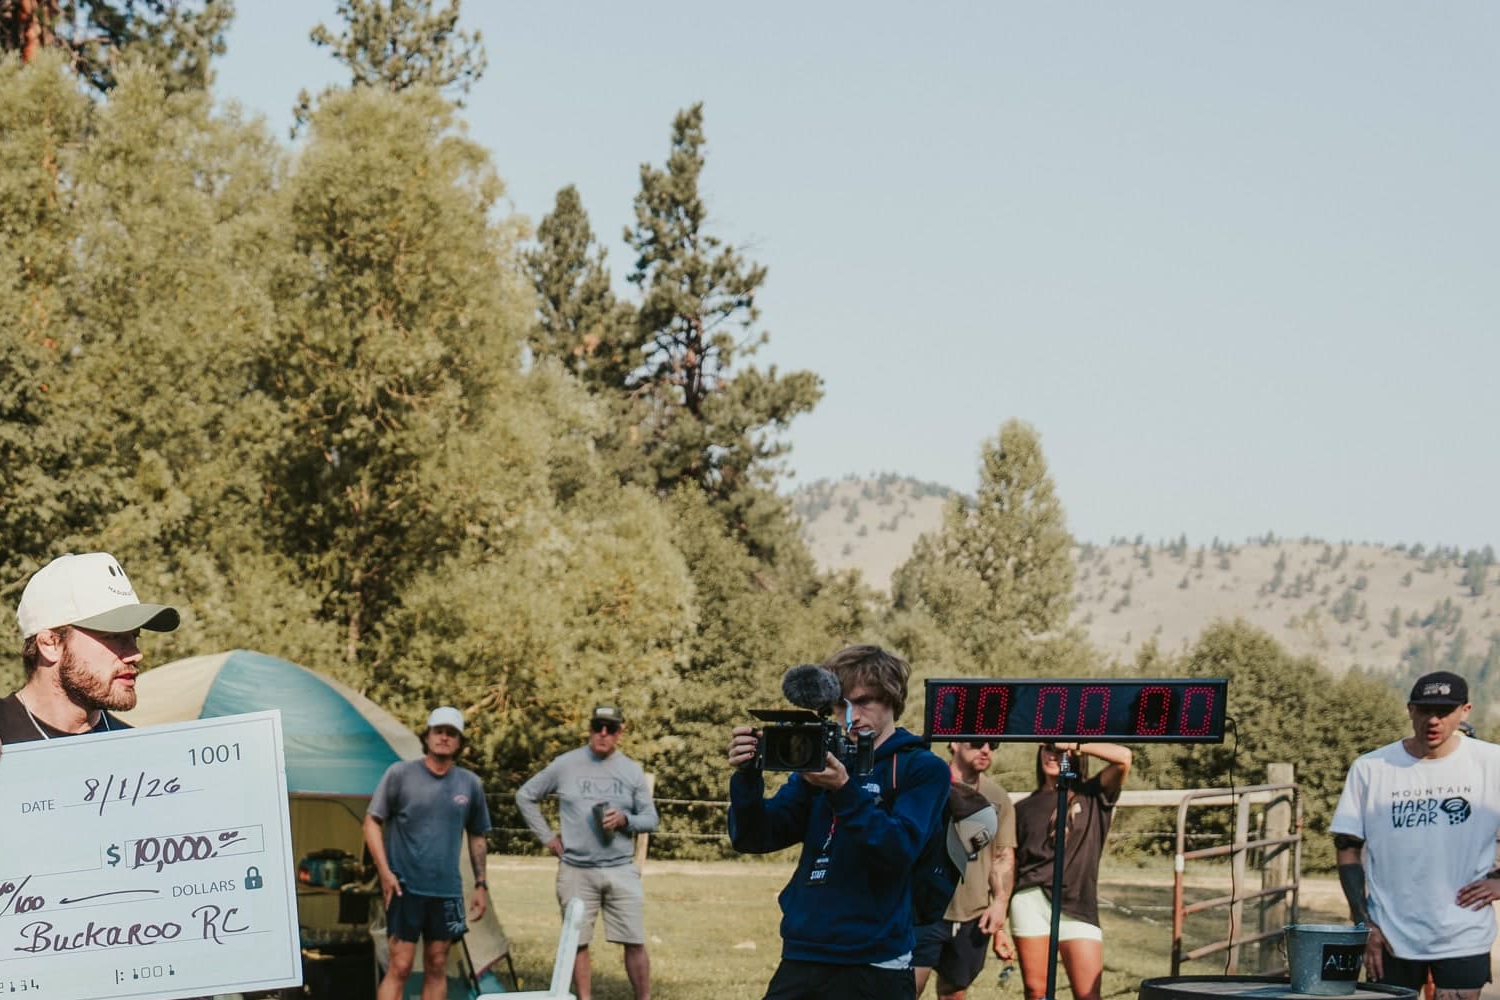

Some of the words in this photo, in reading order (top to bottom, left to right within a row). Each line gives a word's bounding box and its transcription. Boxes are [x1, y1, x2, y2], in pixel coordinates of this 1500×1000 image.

[188, 742, 241, 767] 1001
[83, 771, 181, 816] 8/1/26
[1391, 786, 1472, 798] MOUNTAIN
[21, 800, 55, 814] DATE
[1392, 798, 1438, 814] HARD
[1392, 811, 1438, 828] WEAR
[106, 844, 121, 867] $
[172, 879, 236, 898] DOLLARS
[192, 904, 250, 945] RC
